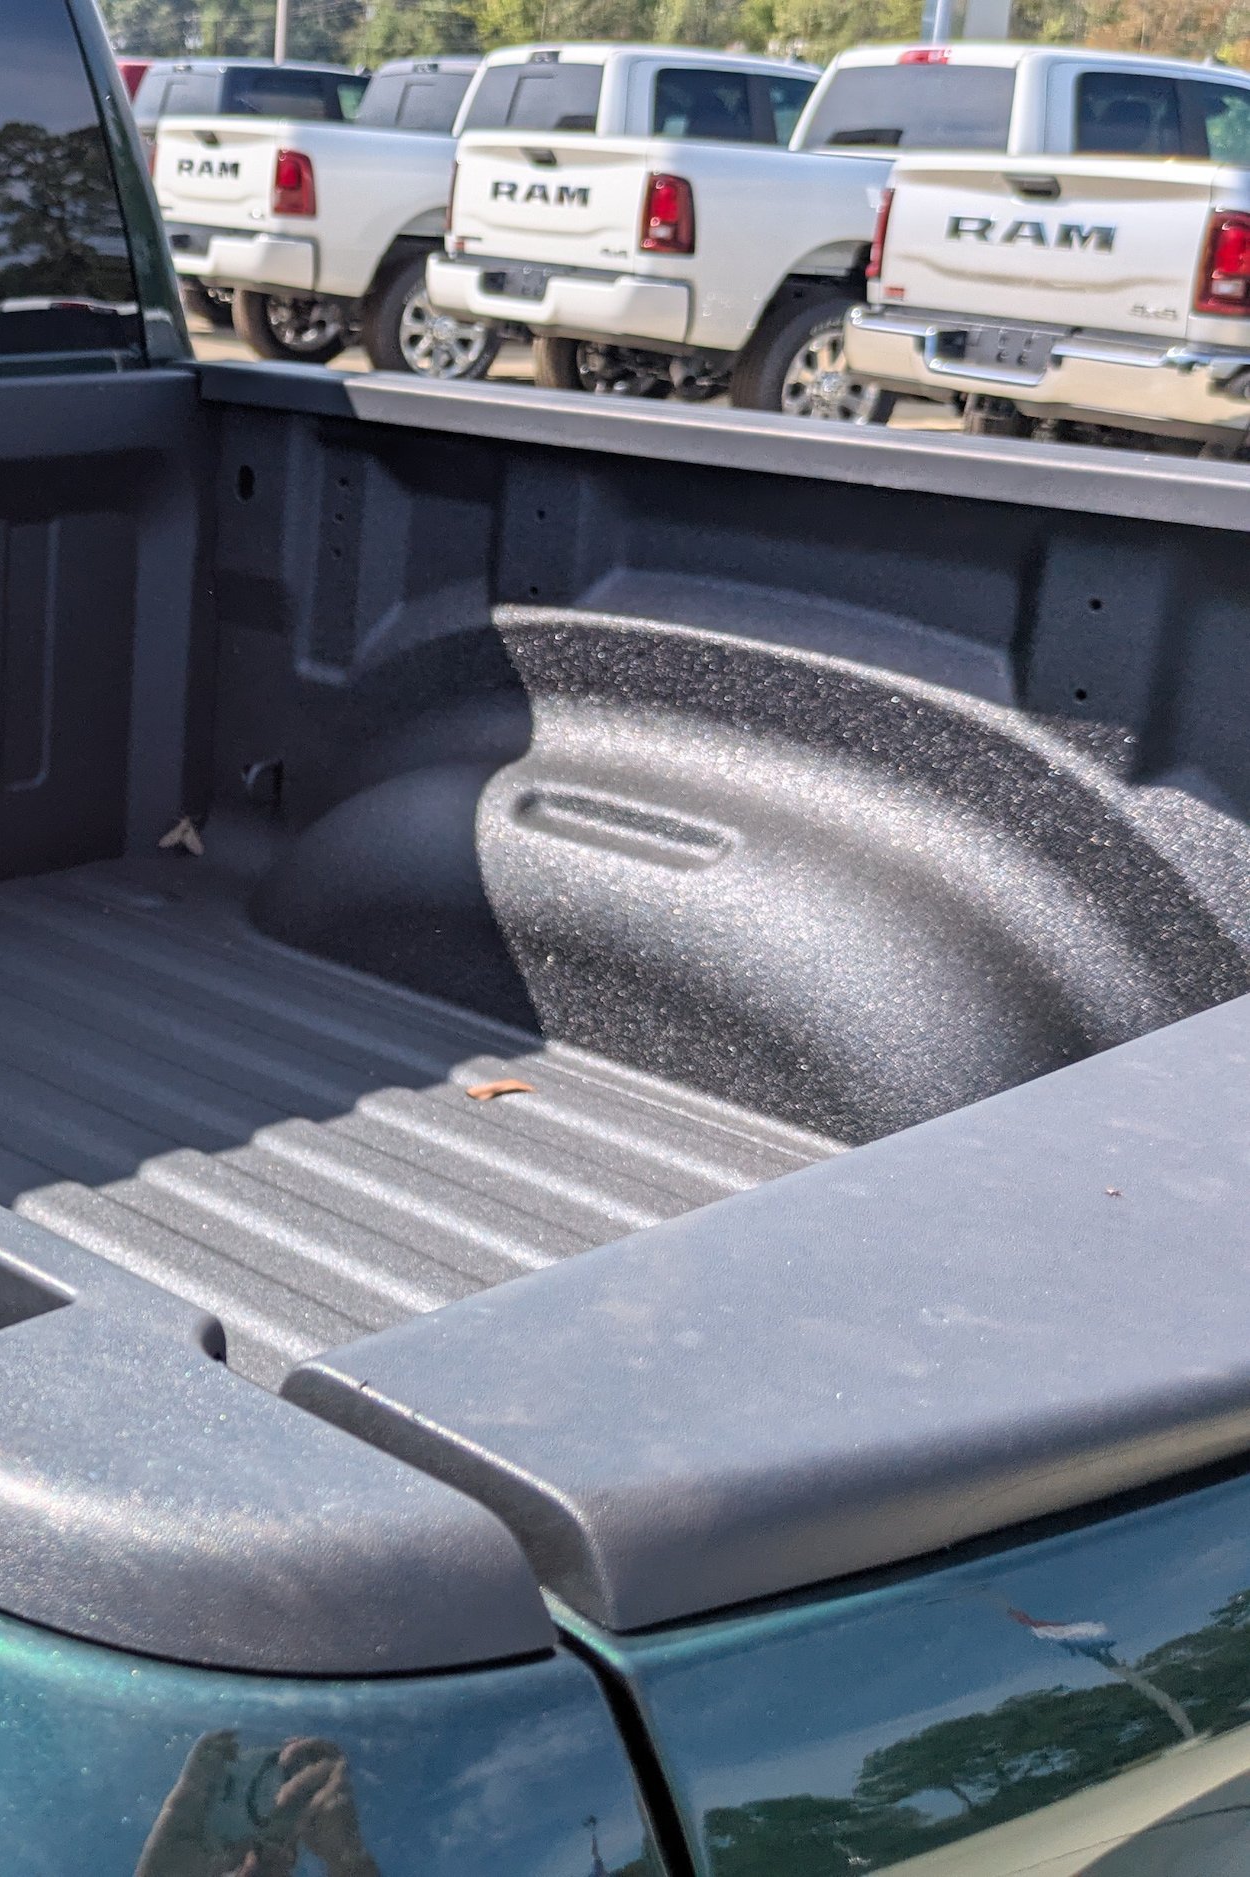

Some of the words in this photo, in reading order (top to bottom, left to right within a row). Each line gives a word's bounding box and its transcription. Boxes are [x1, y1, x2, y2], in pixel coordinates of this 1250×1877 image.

[177, 159, 240, 179] RAM
[490, 181, 591, 207] RAM
[945, 215, 1116, 252] RAM
